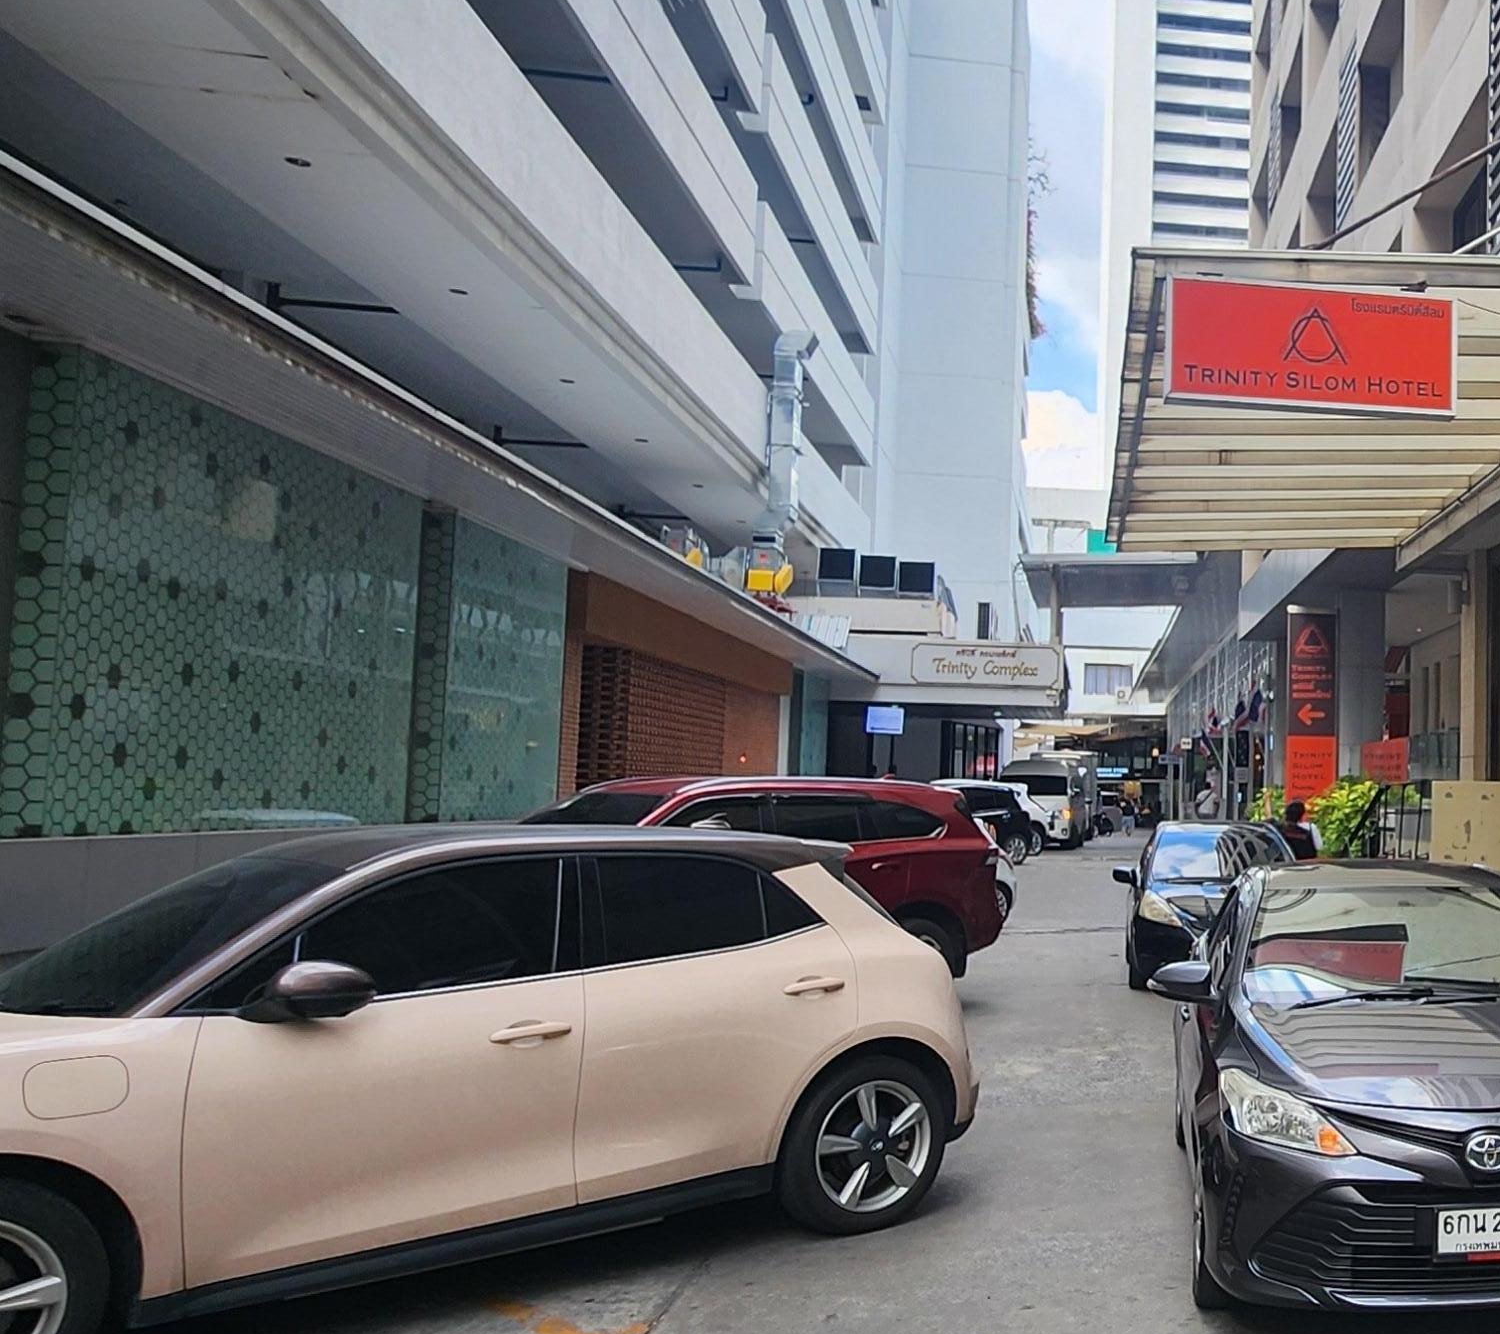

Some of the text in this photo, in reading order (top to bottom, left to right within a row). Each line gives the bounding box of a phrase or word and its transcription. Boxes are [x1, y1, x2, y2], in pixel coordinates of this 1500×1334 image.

[1184, 364, 1443, 397] TRINITY SILOM HOTEL
[933, 657, 1038, 680] Trinity Complex
[1443, 1213, 1487, 1235] 6กน
